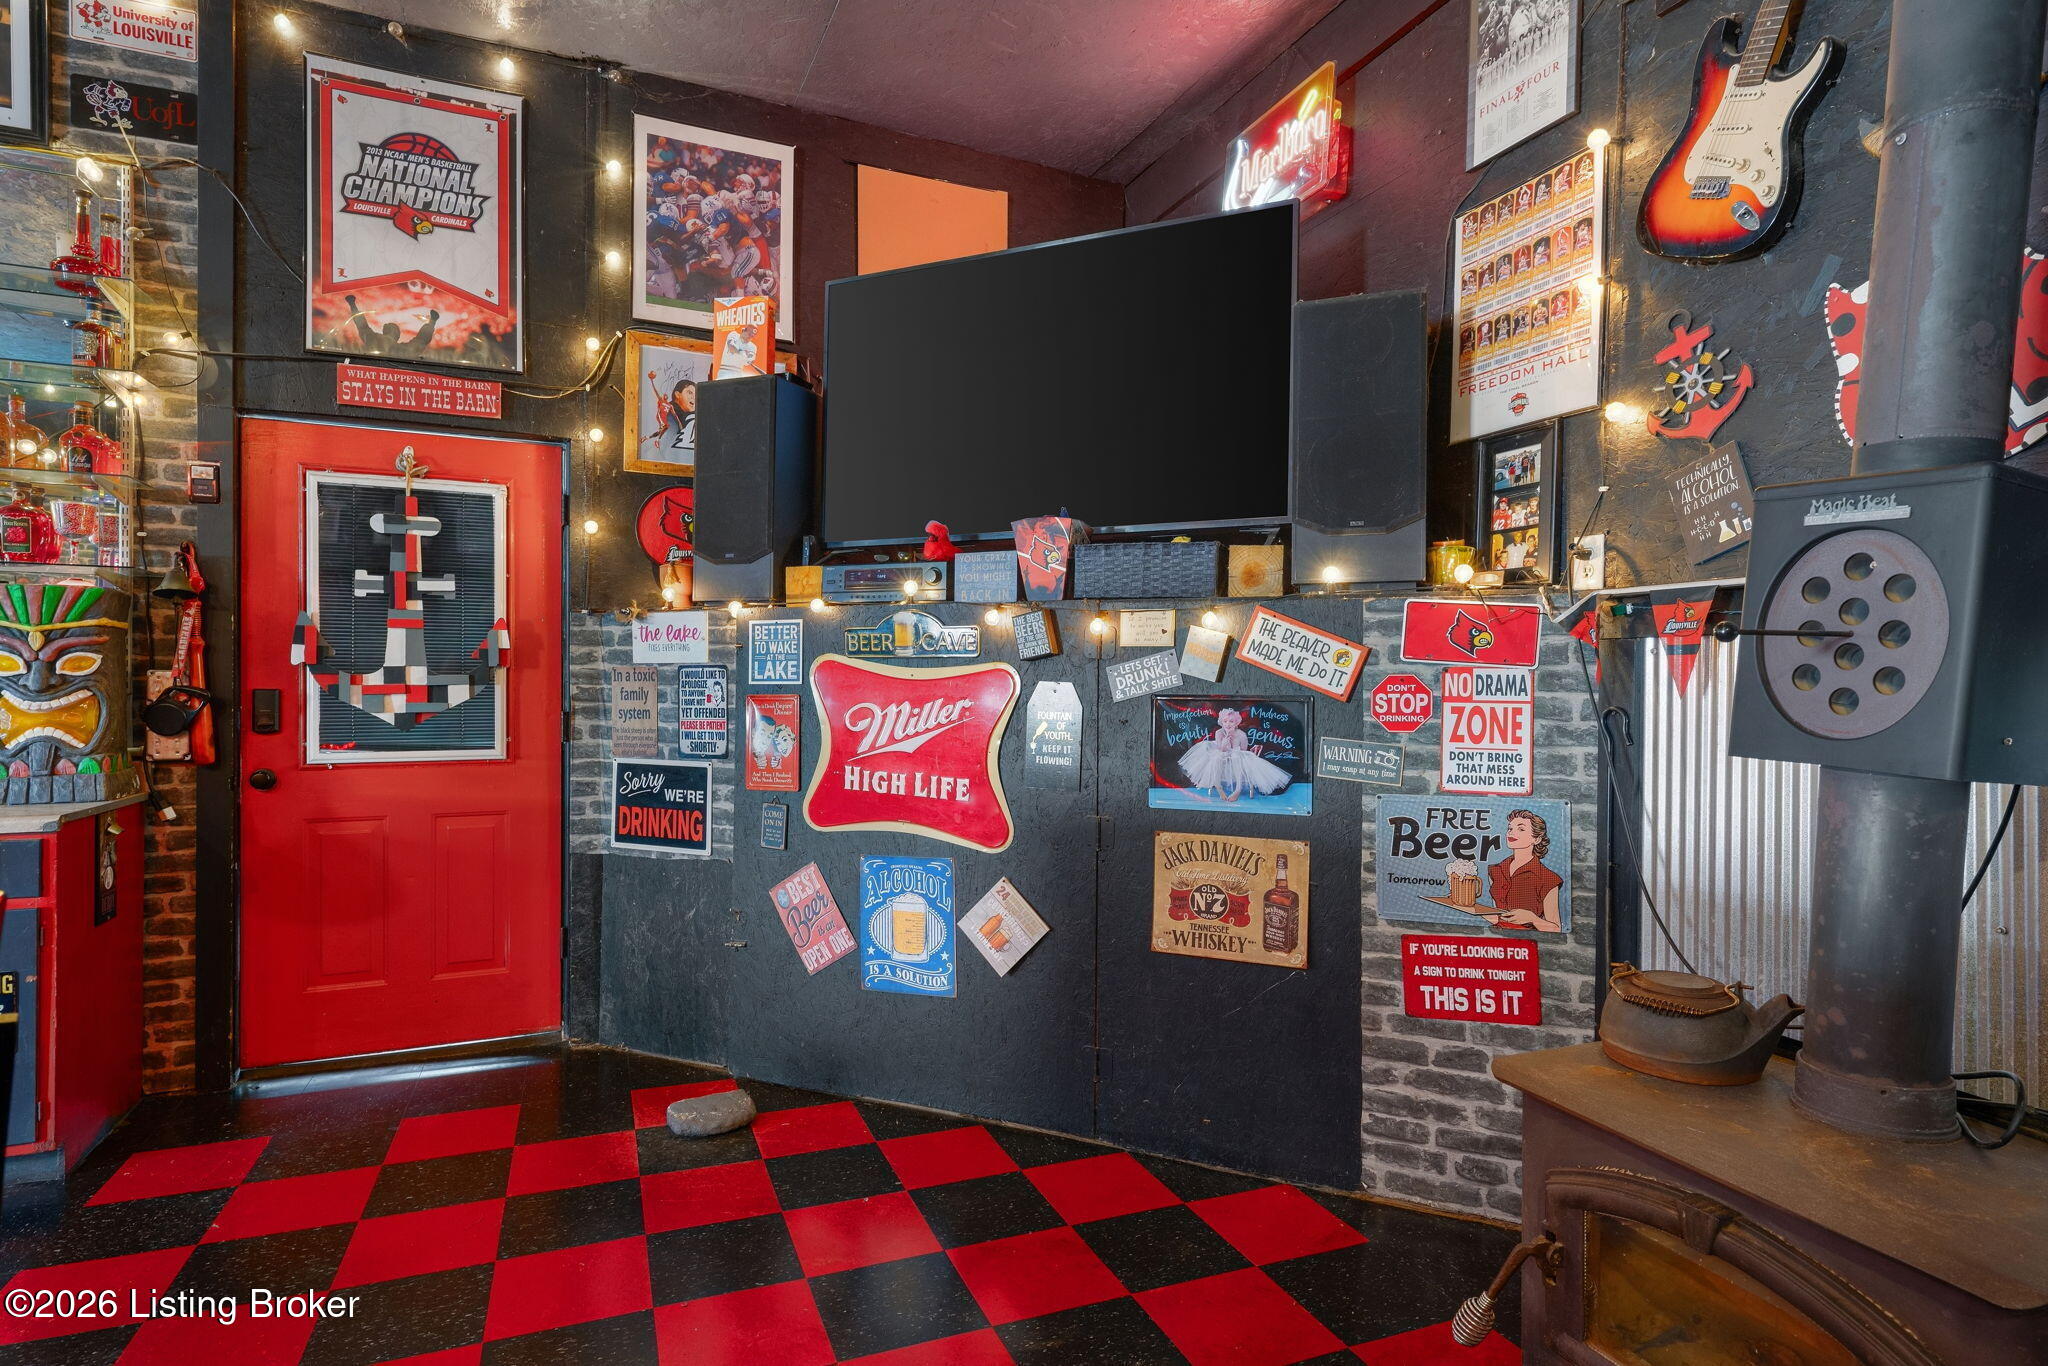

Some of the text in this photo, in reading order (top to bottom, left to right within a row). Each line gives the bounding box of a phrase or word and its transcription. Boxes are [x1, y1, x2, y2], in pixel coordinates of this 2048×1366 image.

[113, 6, 177, 30] University
[180, 21, 194, 31] of
[113, 21, 194, 49] LOUISVILLE
[1480, 91, 1513, 118] FINAL
[1527, 61, 1560, 89] FOUR
[132, 96, 196, 130] UofL
[366, 146, 472, 172] 2013 NCAA MEN'S BASKETBALL
[1239, 106, 1327, 194] Marlboro
[359, 154, 476, 194] NATIONAL
[343, 175, 484, 218] CHAMPIONS
[353, 203, 468, 226] LOUISVILLE CARDINALS
[716, 302, 766, 327] WHEATIES
[347, 369, 492, 391] WHAT HAPPENS IN THE BARN
[1459, 364, 1535, 398] FREEDOM
[1543, 349, 1589, 372] HALL
[342, 382, 497, 413] STAYS IN THE BARN
[1681, 465, 1738, 504] ALCOHOL
[1684, 504, 1691, 515] IS
[1694, 501, 1699, 510] A
[1810, 492, 1898, 520] Magic Heat
[1014, 611, 1043, 626] THE BEST
[638, 624, 700, 643] the lake
[754, 625, 798, 640] BETTER
[1014, 620, 1046, 638] BEERS
[662, 644, 690, 652] EVERYTHING
[754, 640, 798, 654] TO WAKE
[848, 632, 978, 652] BEER CAVE
[1257, 616, 1332, 664] THE BEAVER
[1020, 644, 1050, 660] FRIENDS
[1246, 638, 1288, 666] MADE
[1285, 653, 1308, 675] ME
[612, 668, 656, 682] In a toxic
[684, 670, 726, 680] WOULD LIKE TO
[754, 660, 798, 680] LAKE
[1120, 655, 1162, 675] LETS GET
[681, 680, 708, 689] APOLOGIZE
[1116, 662, 1170, 690] DRUNK!
[1444, 672, 1529, 697] NO DRAMA
[620, 687, 649, 705] family
[1116, 674, 1178, 700] & TALK SHITE
[1386, 684, 1416, 692] DON'T
[681, 708, 726, 718] YET OFFENDED
[1374, 693, 1429, 714] STOP
[618, 707, 651, 723] system
[1037, 711, 1073, 722] FOUNTAIN
[1163, 707, 1213, 723] Imperfection
[1250, 706, 1289, 722] Madness
[1380, 715, 1425, 723] DRINKING
[681, 720, 726, 730] PLEASE BE PATIENT
[844, 698, 975, 754] Miller
[1056, 722, 1066, 730] OF
[1262, 720, 1270, 729] is
[1448, 705, 1524, 745] ZONE
[684, 731, 726, 741] WILL GET TO YOU
[1166, 725, 1212, 747] beauty
[1042, 744, 1072, 754] KEEP IT
[1322, 745, 1372, 765] WARNING
[1449, 751, 1524, 764] DON'T BRING
[1036, 756, 1073, 766] FLOWING!
[1327, 764, 1341, 773] may
[1342, 765, 1357, 775] snap
[1358, 766, 1366, 776] at
[1367, 768, 1380, 778] any
[1381, 768, 1396, 778] time
[1456, 763, 1516, 775] THAT MESS
[619, 771, 666, 795] Sorry
[844, 764, 971, 802] HIGH LIFE
[1446, 774, 1526, 788] AROUND HERE
[664, 789, 705, 804] WE'RE
[618, 805, 704, 842] DRINKING
[1426, 807, 1492, 831] FREE
[1388, 816, 1502, 862] Beer
[1161, 840, 1266, 876] JACK DANIEL'S
[785, 866, 821, 905] BEST
[1387, 872, 1446, 887] Tomorrow
[864, 868, 952, 912] ALCOHOL
[787, 890, 830, 949] Beer
[1190, 922, 1230, 934] TENNESSEE
[801, 927, 855, 971] OPEN ONE
[1172, 929, 1249, 954] WHISKEY
[1410, 943, 1530, 960] IF YOU'RE LOOKING FOR
[868, 964, 949, 988] IS A SOLUTION
[1414, 966, 1526, 982] A SIGN TO DRINK TONIGHT
[1420, 985, 1524, 1016] THIS IS IT
